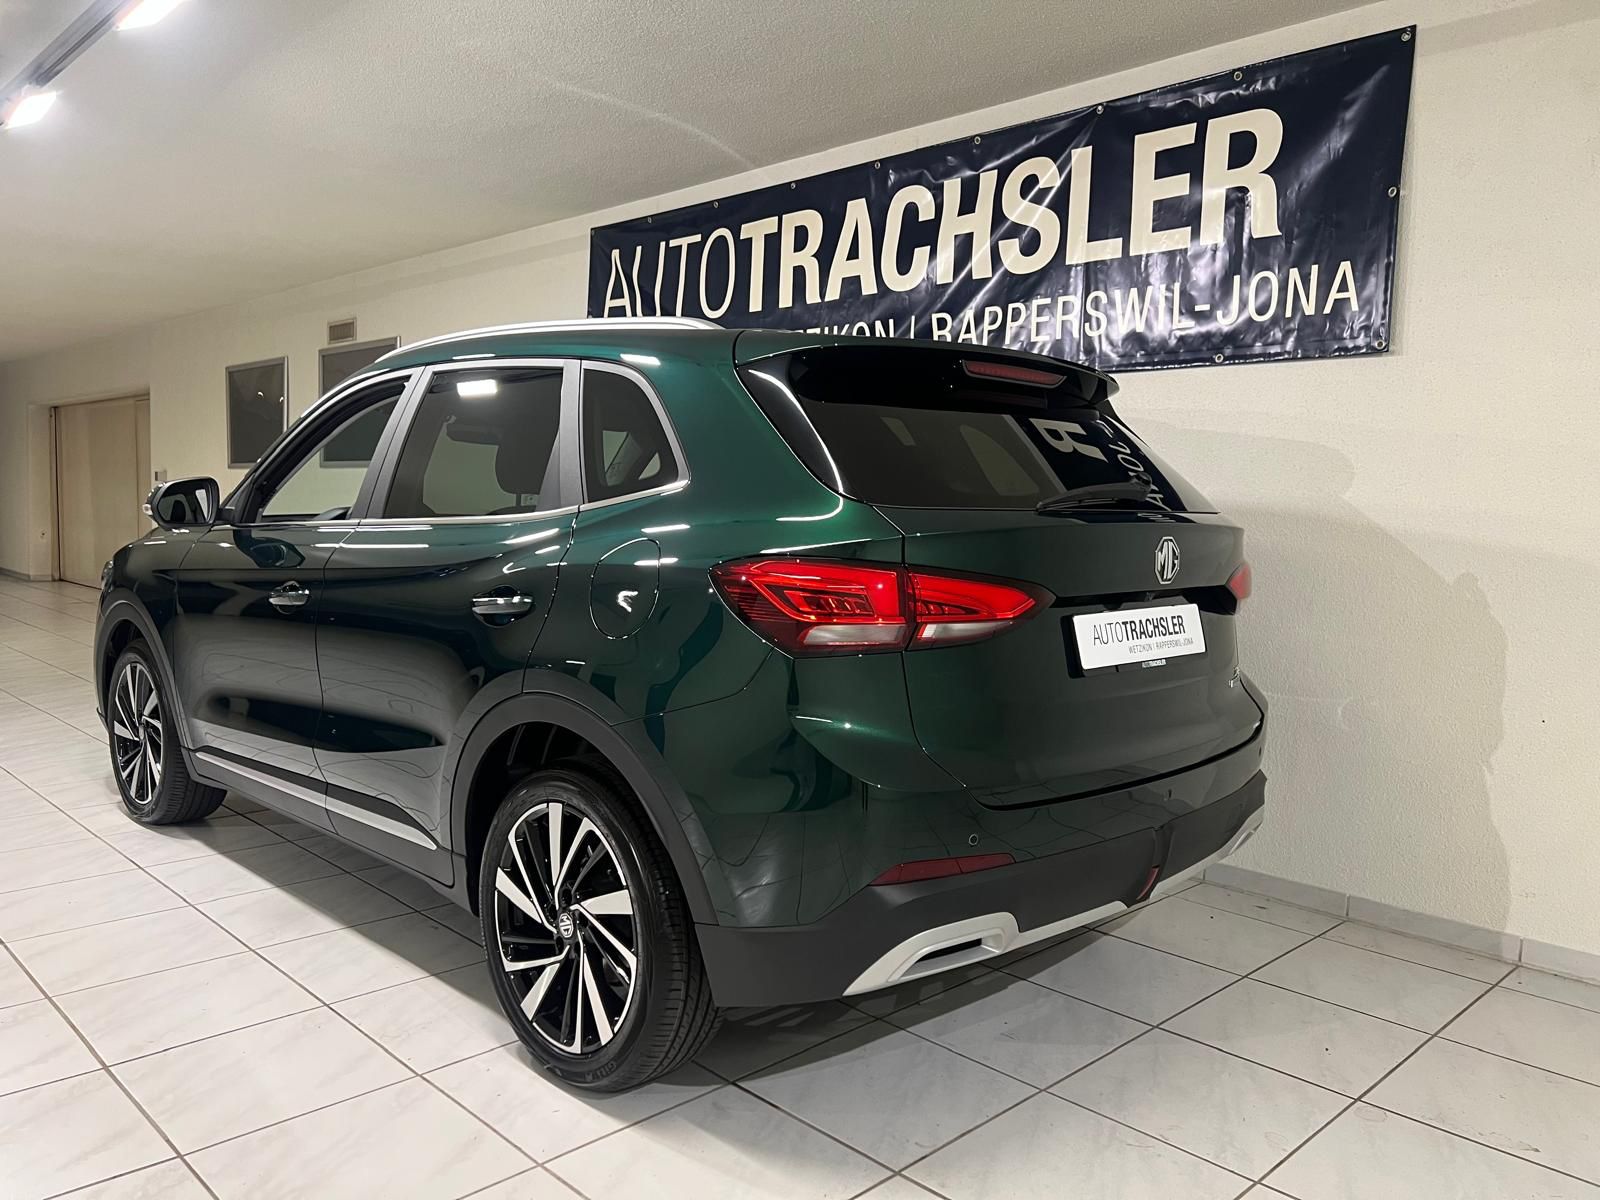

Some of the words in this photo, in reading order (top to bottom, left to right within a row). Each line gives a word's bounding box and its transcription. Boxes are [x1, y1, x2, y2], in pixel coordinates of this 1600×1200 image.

[604, 108, 1283, 319] AUTOTRACHSLER
[932, 260, 1359, 347] RAPPERSWIL-JONA
[1158, 540, 1179, 580] MG
[1093, 614, 1186, 646] AUTOTRACHSLER
